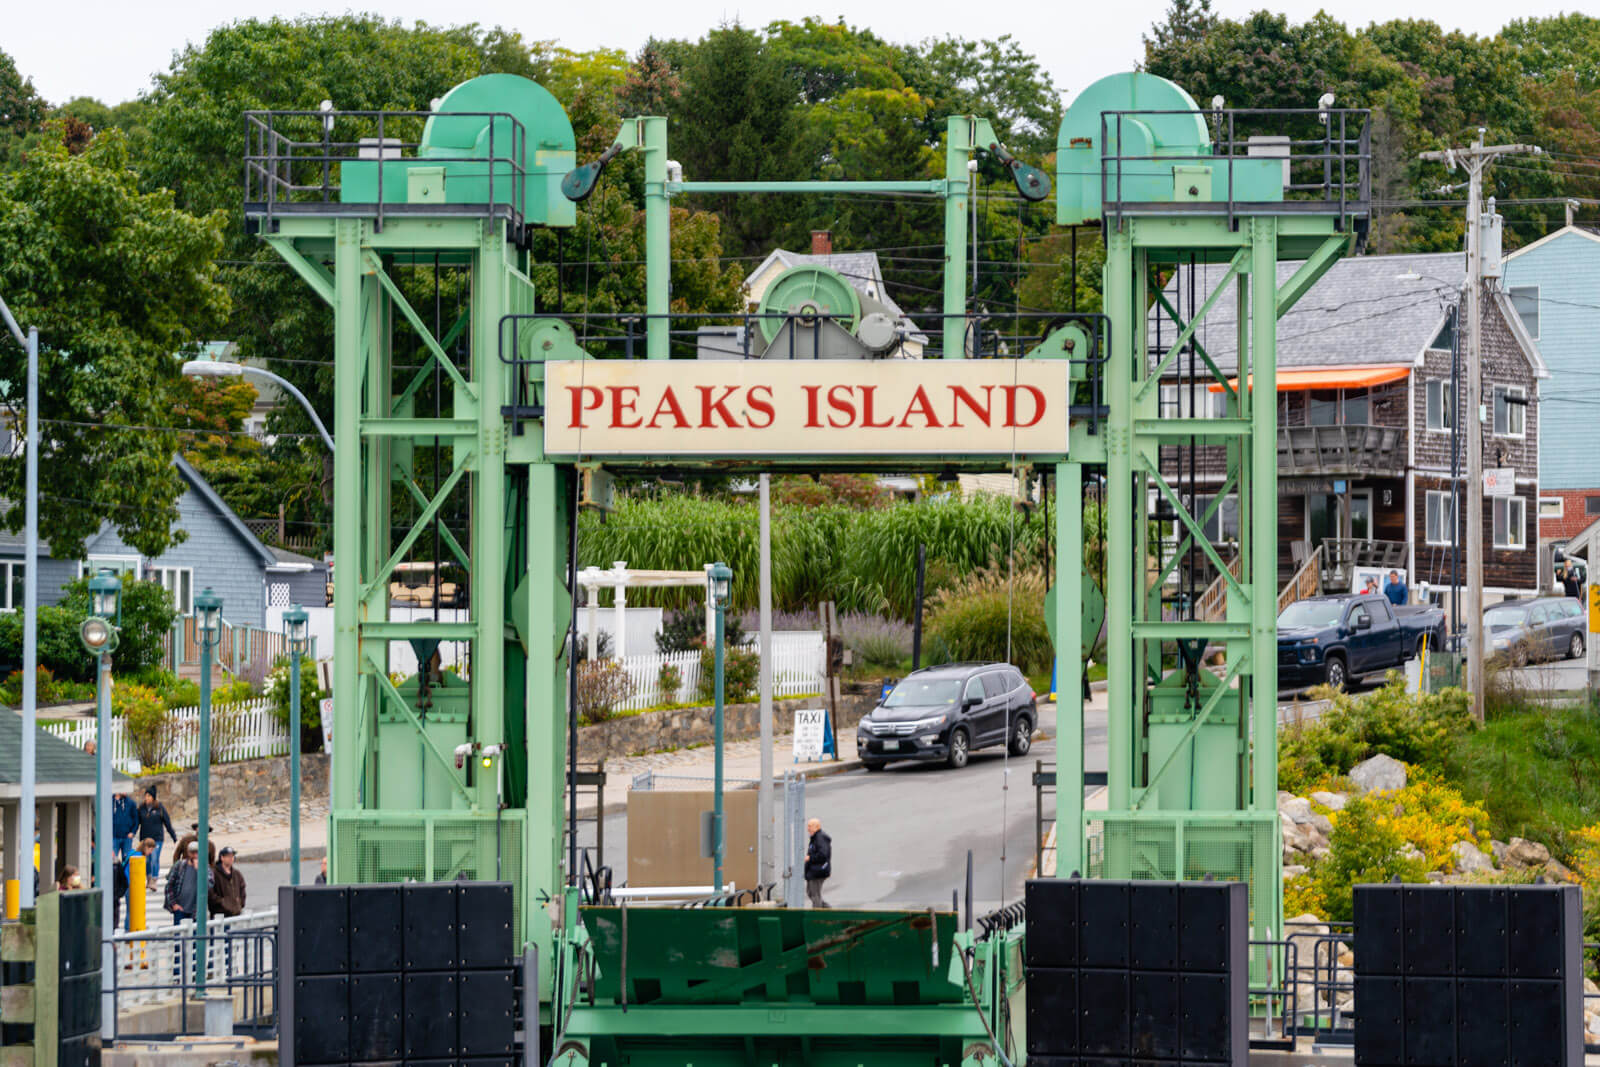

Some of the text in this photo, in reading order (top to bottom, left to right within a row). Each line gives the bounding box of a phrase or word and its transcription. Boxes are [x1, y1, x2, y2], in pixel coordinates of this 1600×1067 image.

[565, 385, 1047, 428] PEAKS ISLAND
[797, 712, 821, 724] TAXI
